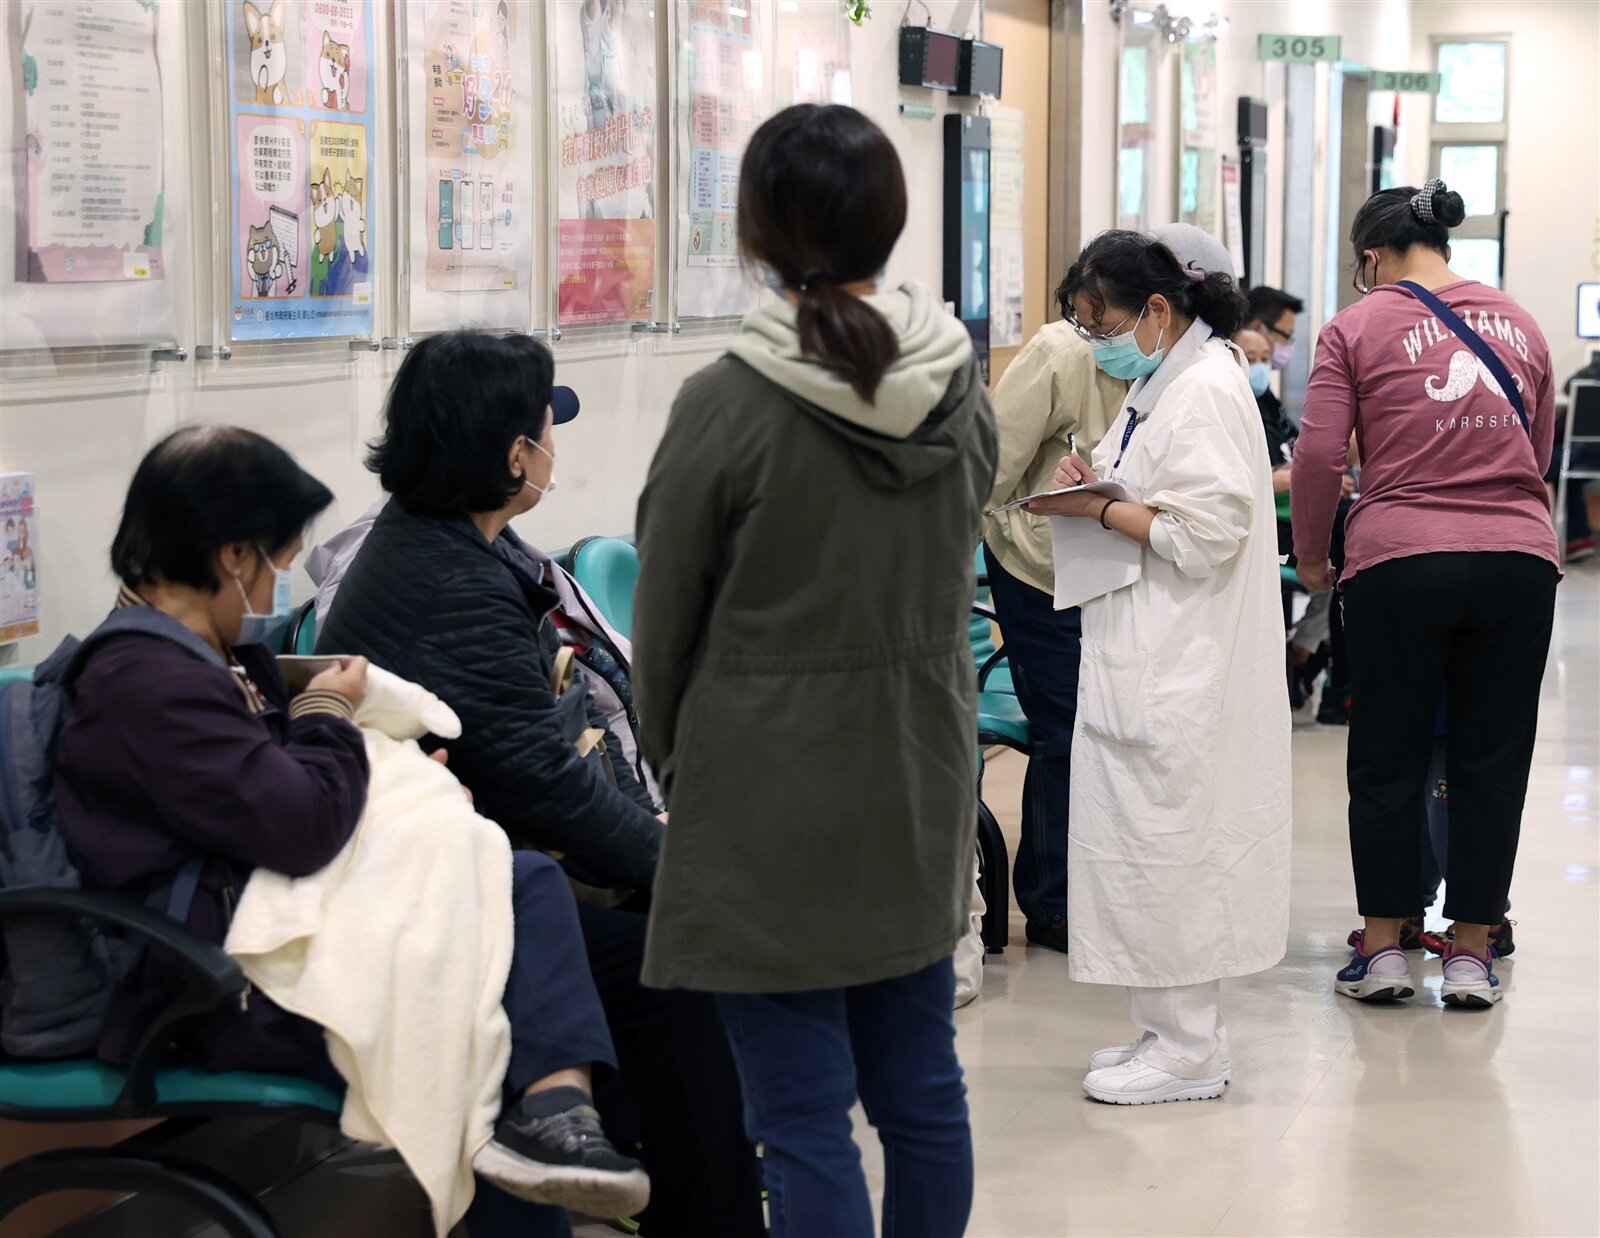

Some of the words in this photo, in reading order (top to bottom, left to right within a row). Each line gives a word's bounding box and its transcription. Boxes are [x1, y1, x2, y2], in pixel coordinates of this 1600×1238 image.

[1273, 38, 1325, 58] 305
[1383, 74, 1429, 91] 306
[1402, 309, 1528, 365] WILIAMS
[1436, 413, 1521, 432] KARSSEN
